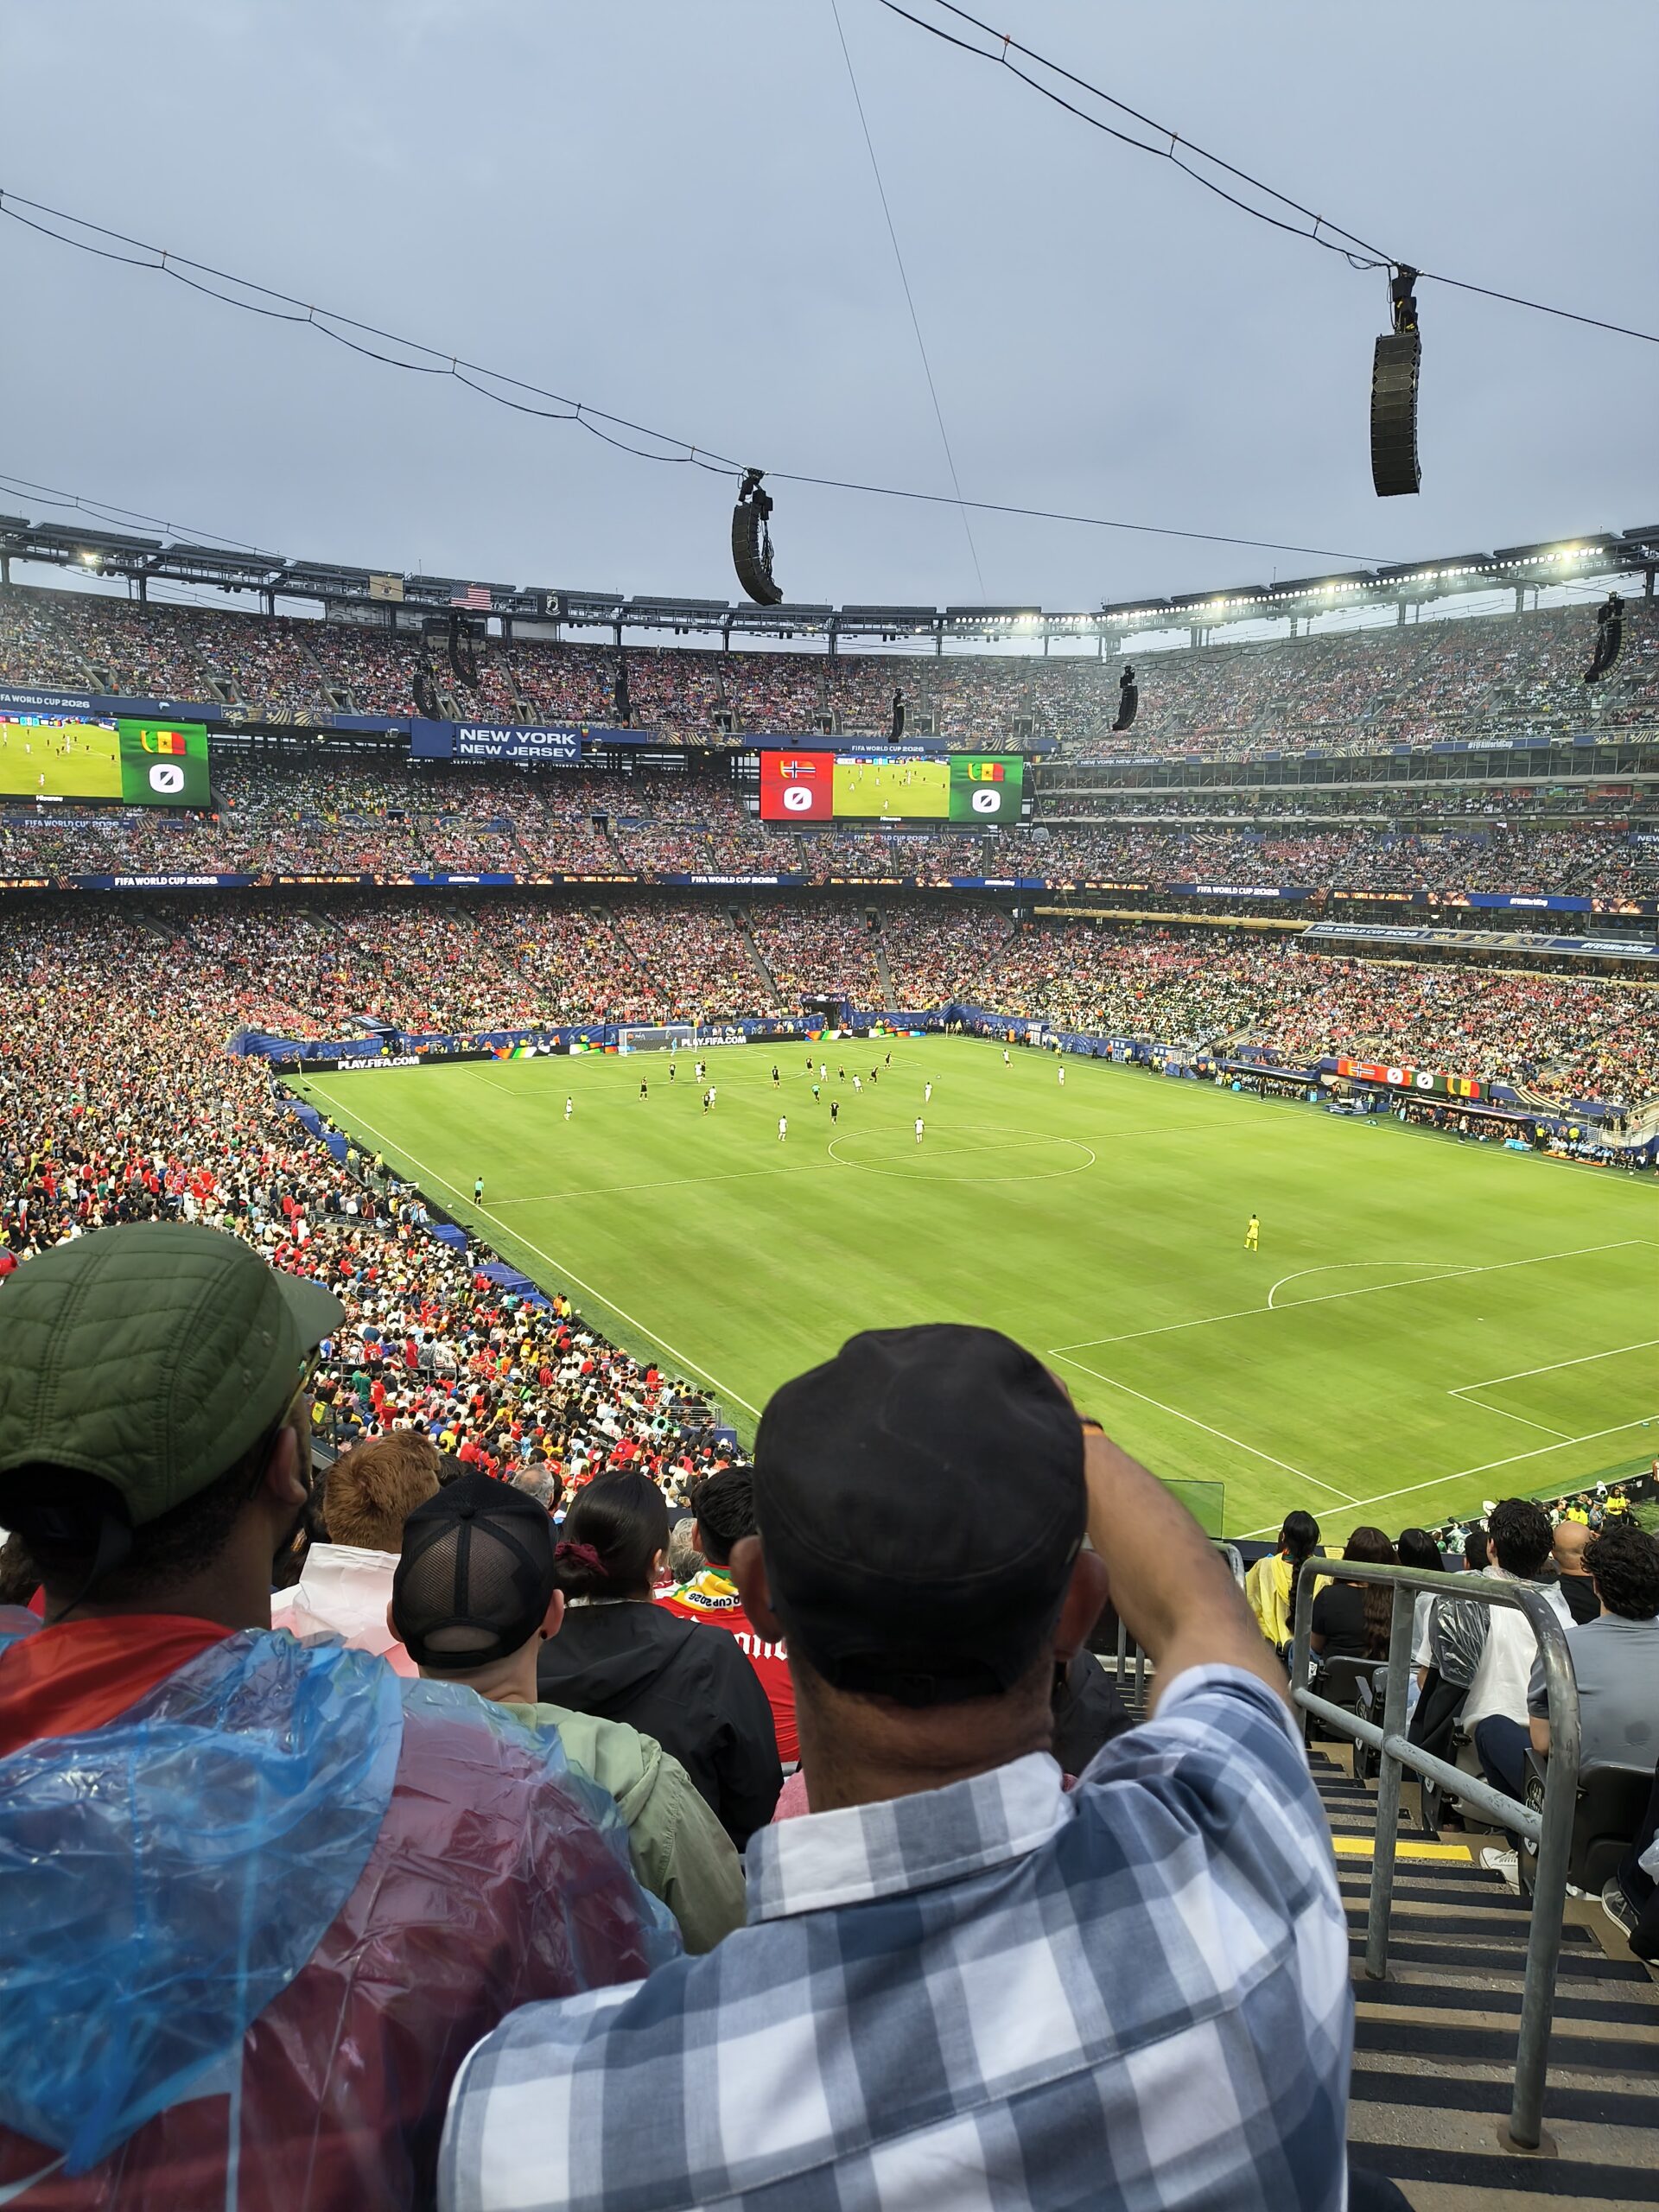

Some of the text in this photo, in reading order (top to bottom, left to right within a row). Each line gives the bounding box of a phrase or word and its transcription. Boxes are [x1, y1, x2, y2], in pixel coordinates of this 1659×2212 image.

[12, 695, 43, 704] WORLD
[44, 697, 60, 706] CUP
[61, 699, 91, 709] 2026
[460, 728, 576, 745] NEW YORK
[1467, 740, 1513, 749] #FIFAWorldCup
[461, 744, 576, 758] NEW JERSEY
[115, 877, 135, 886] FIFA
[136, 877, 168, 886] WORLD
[168, 876, 186, 885] CUP
[1238, 887, 1253, 895] CUP
[1254, 887, 1280, 896] 2026
[1580, 942, 1654, 954] #FIFAWorldCup
[681, 1035, 747, 1047] PLAY.FIFA.COM
[337, 1055, 420, 1071] PLAY.FIFA.COM
[688, 1592, 711, 1607] 2026
[713, 1598, 732, 1607] CUP
